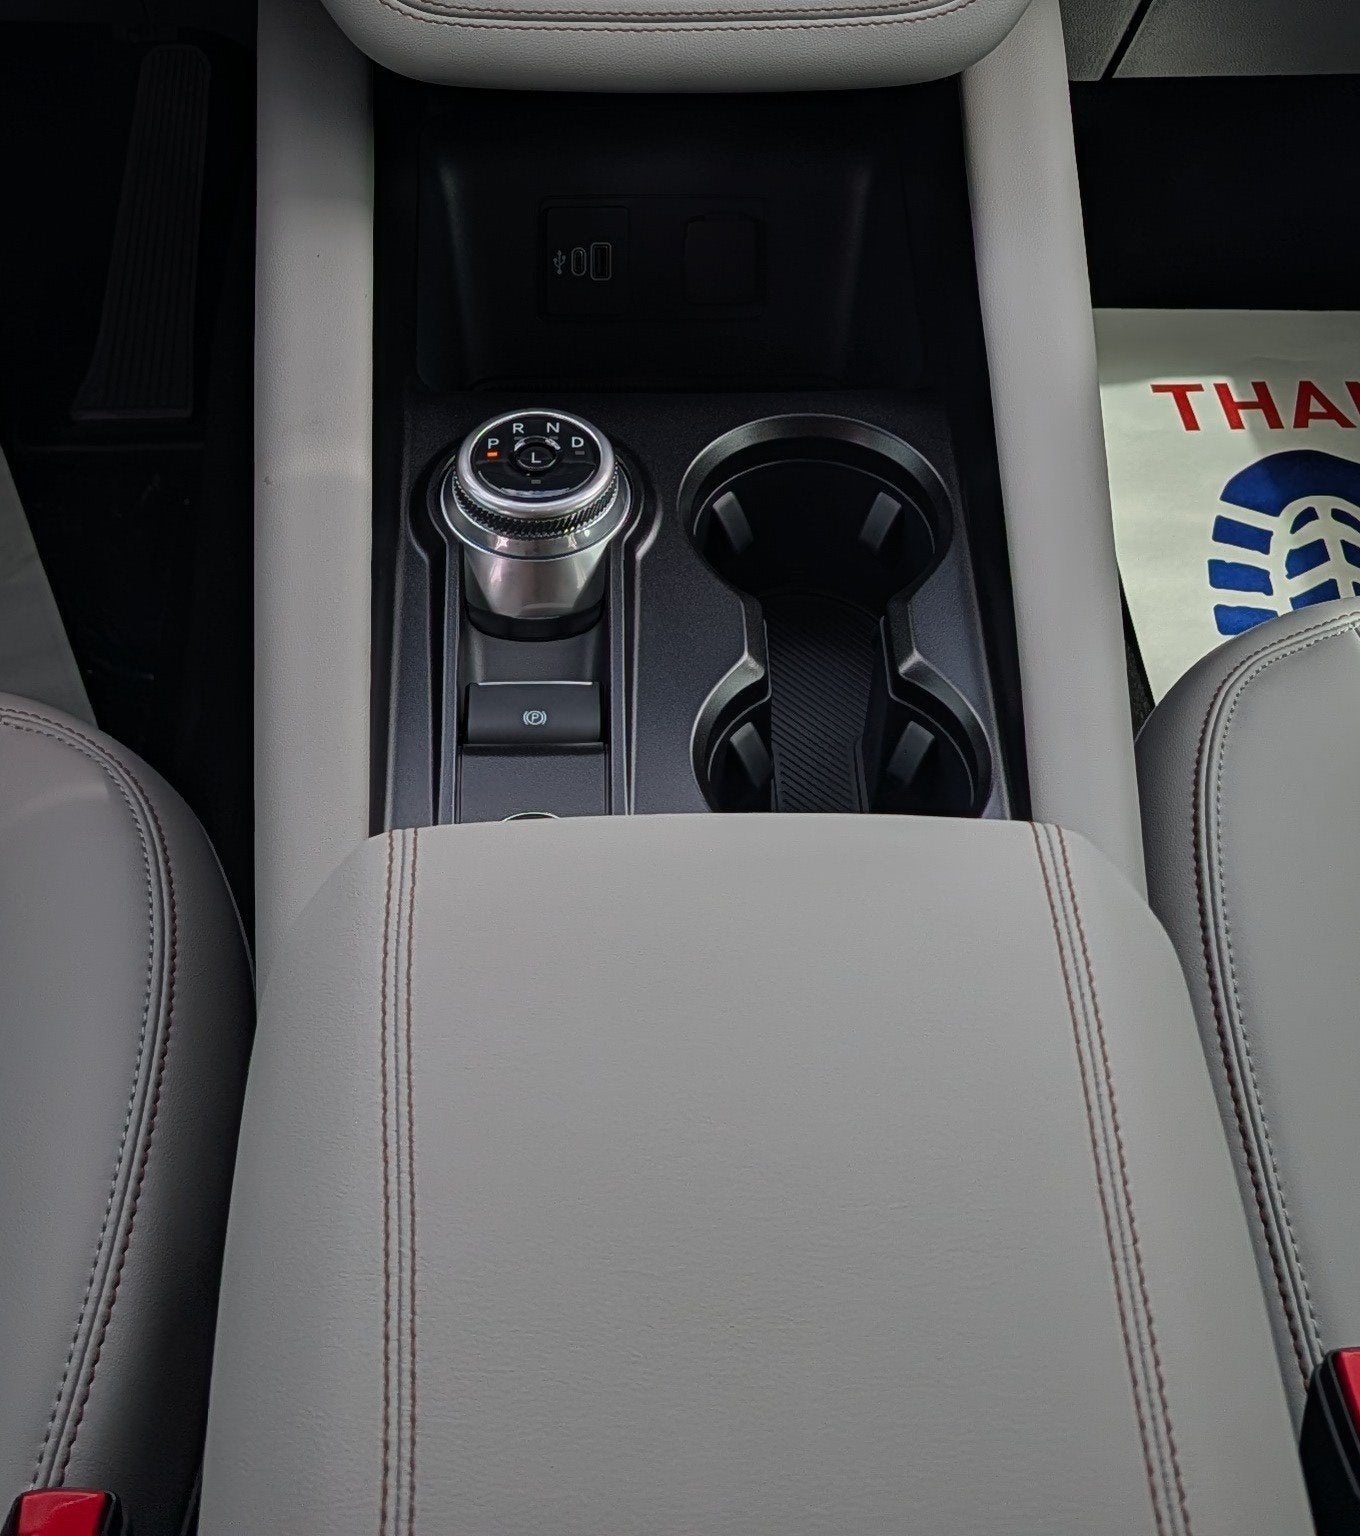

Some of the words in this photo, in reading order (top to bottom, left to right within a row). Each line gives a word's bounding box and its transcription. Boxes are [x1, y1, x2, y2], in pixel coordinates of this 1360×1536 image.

[511, 421, 526, 435] R
[545, 421, 561, 435] N
[487, 437, 501, 450] P
[570, 435, 585, 449] D
[530, 451, 542, 464] L
